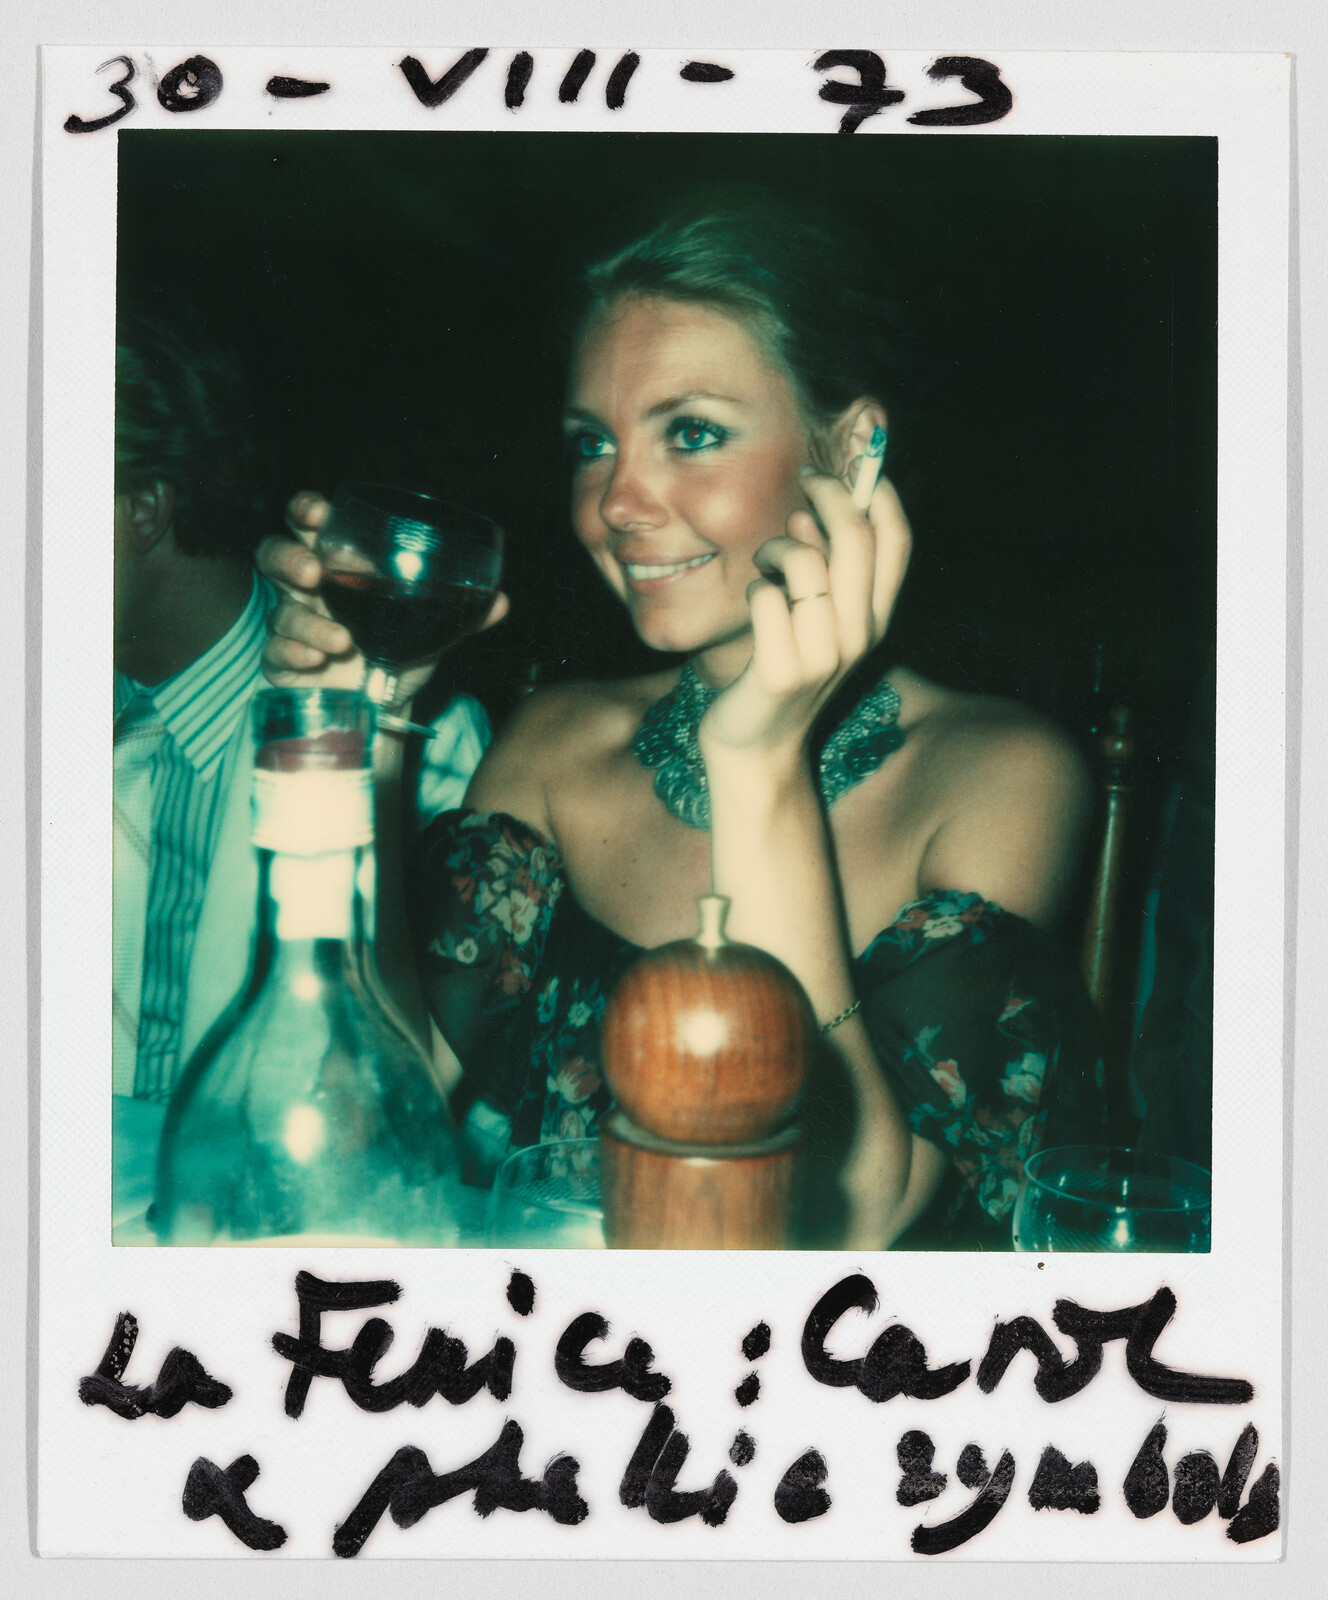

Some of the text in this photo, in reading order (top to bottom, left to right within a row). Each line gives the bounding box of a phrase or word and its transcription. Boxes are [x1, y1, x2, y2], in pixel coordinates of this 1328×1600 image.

[78, 1311, 234, 1421] La
[271, 1269, 675, 1421] Fenice
[800, 1273, 1255, 1405] Carol
